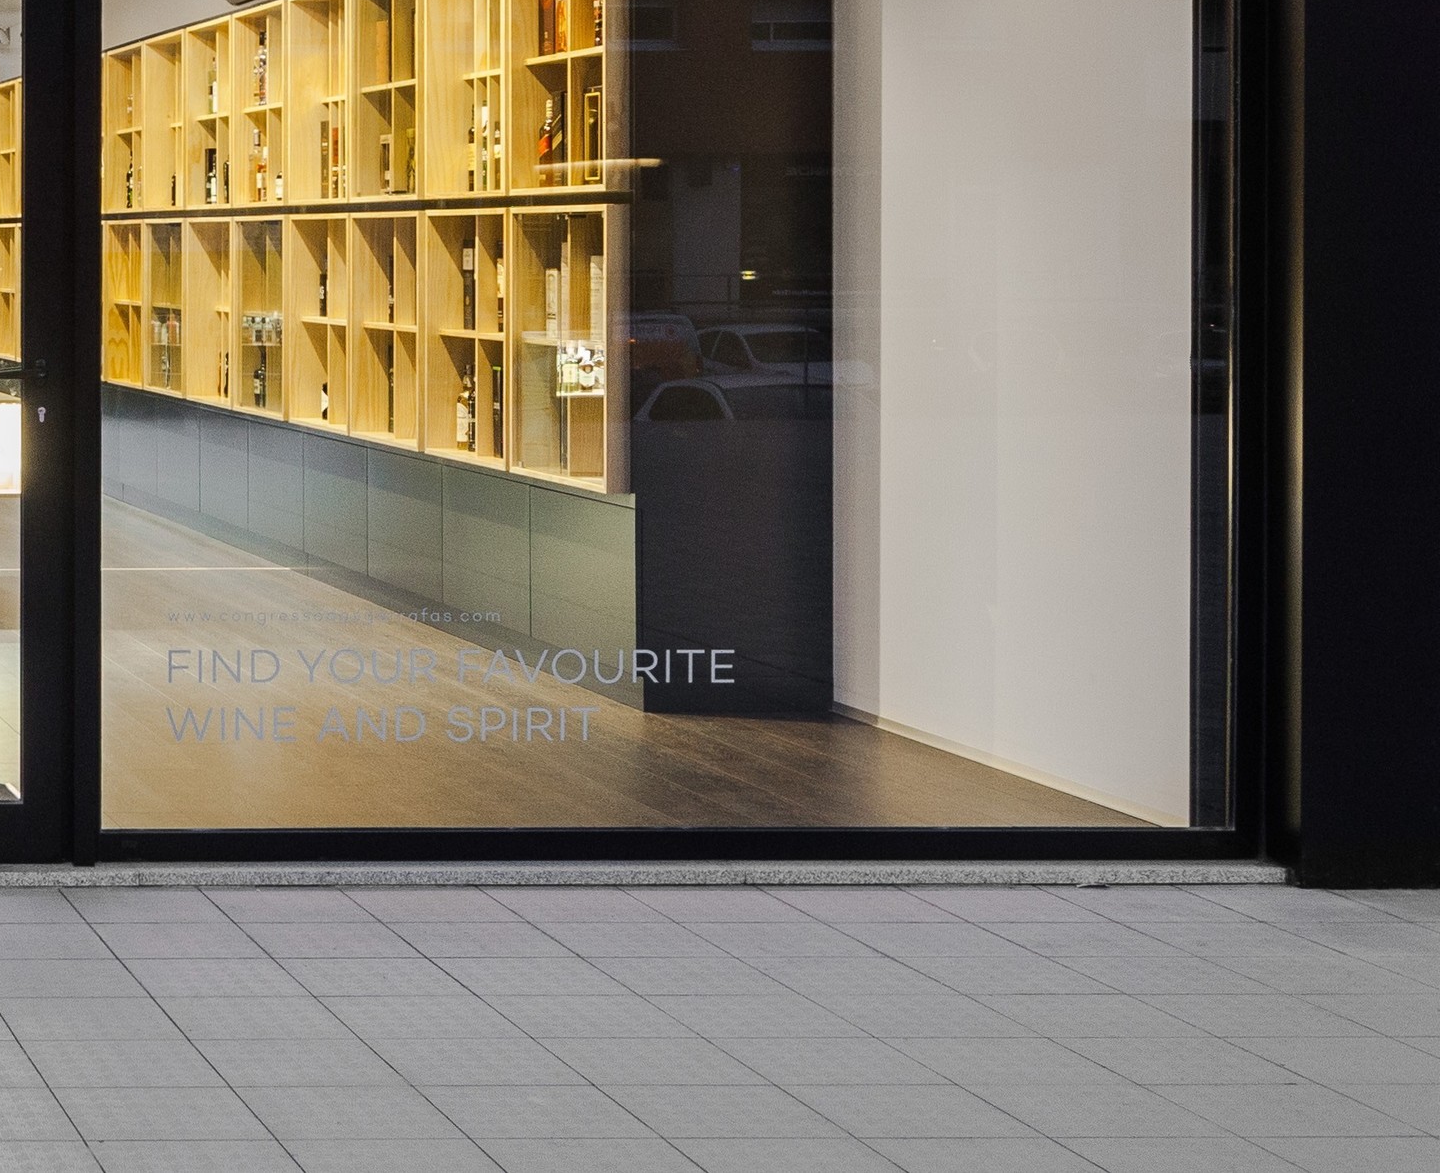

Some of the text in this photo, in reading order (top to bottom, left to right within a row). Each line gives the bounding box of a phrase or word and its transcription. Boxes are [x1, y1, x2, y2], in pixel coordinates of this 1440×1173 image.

[167, 648, 736, 684] FIND YOUR FAVOURITE
[166, 705, 600, 743] WINE AND SPIRIT
